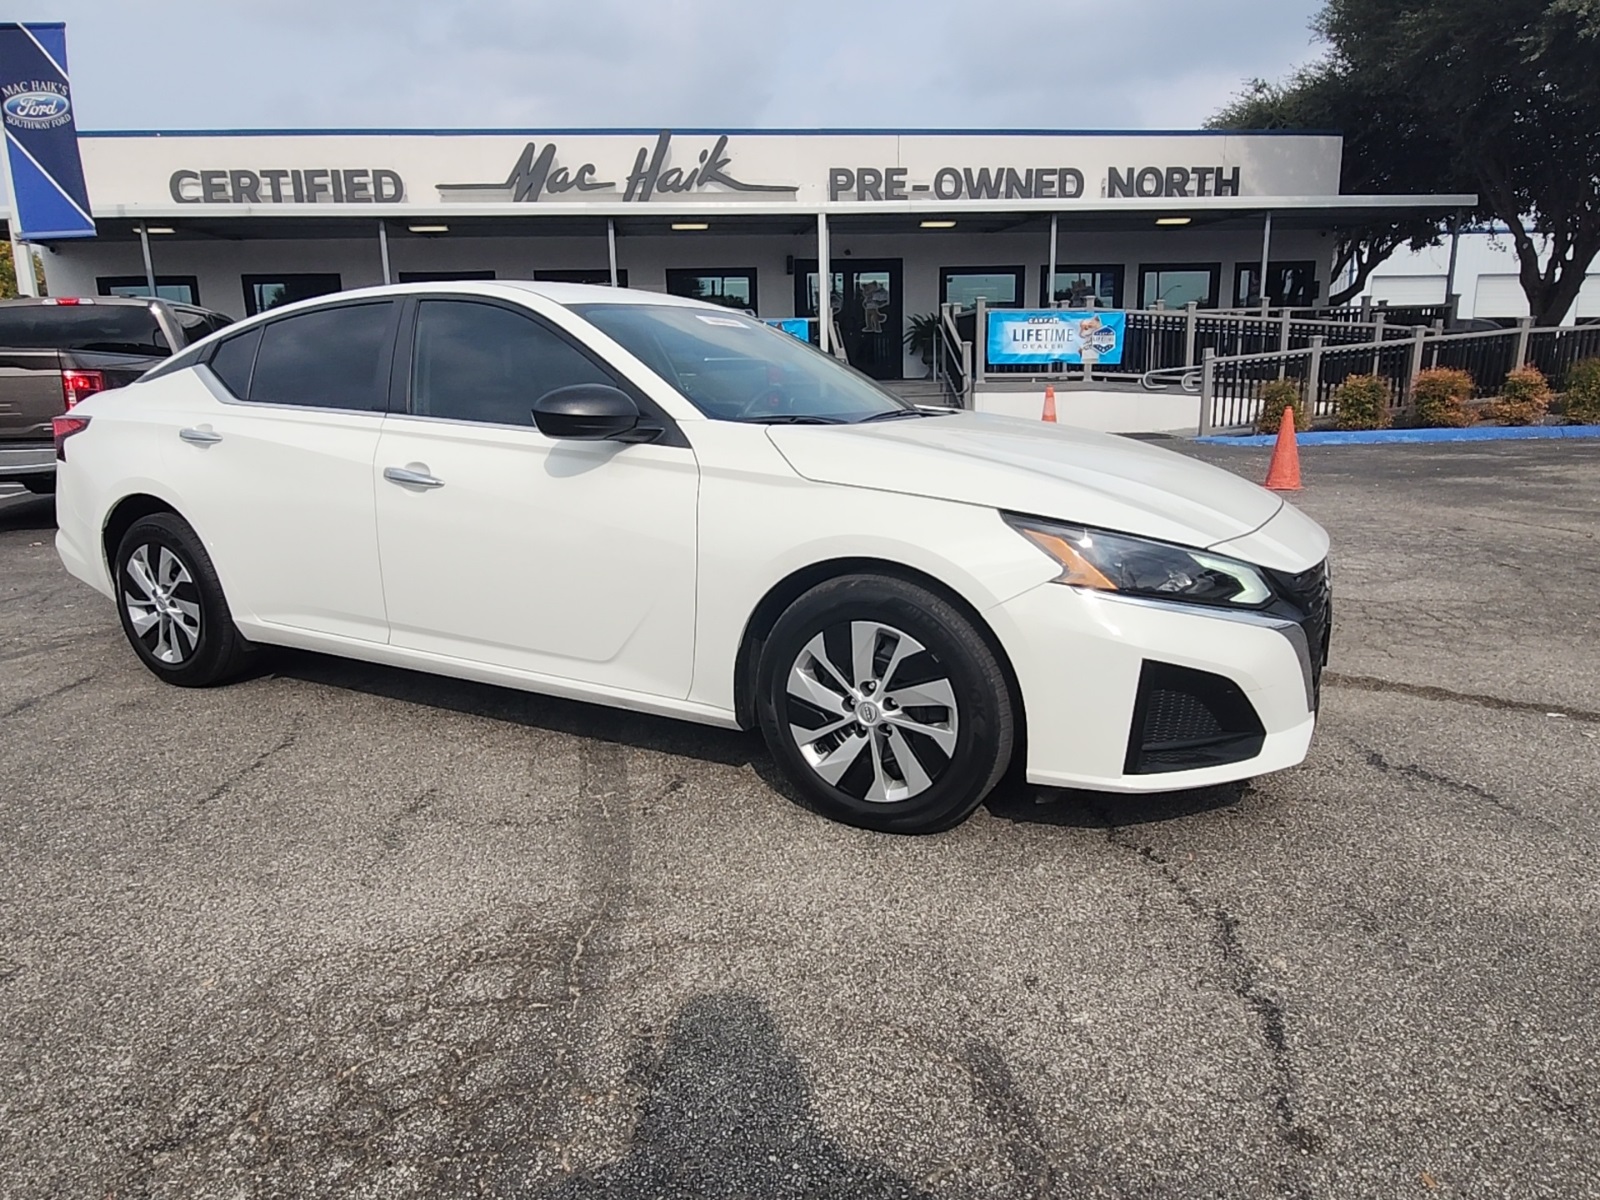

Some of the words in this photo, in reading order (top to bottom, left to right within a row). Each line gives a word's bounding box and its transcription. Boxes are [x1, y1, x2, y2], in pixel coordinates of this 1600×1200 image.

[1, 81, 28, 97] MAC
[31, 80, 68, 96] HAIK'S
[17, 96, 58, 116] Ford
[6, 116, 51, 129] SOUTHWAY
[51, 114, 71, 128] FORD
[435, 142, 616, 202] Mac
[622, 129, 800, 202] Haik
[169, 169, 404, 204] CERTIFIED
[828, 167, 1085, 201] PRE-OWNED
[1107, 166, 1241, 198] NORTH
[1012, 328, 1074, 343] LIFETIME
